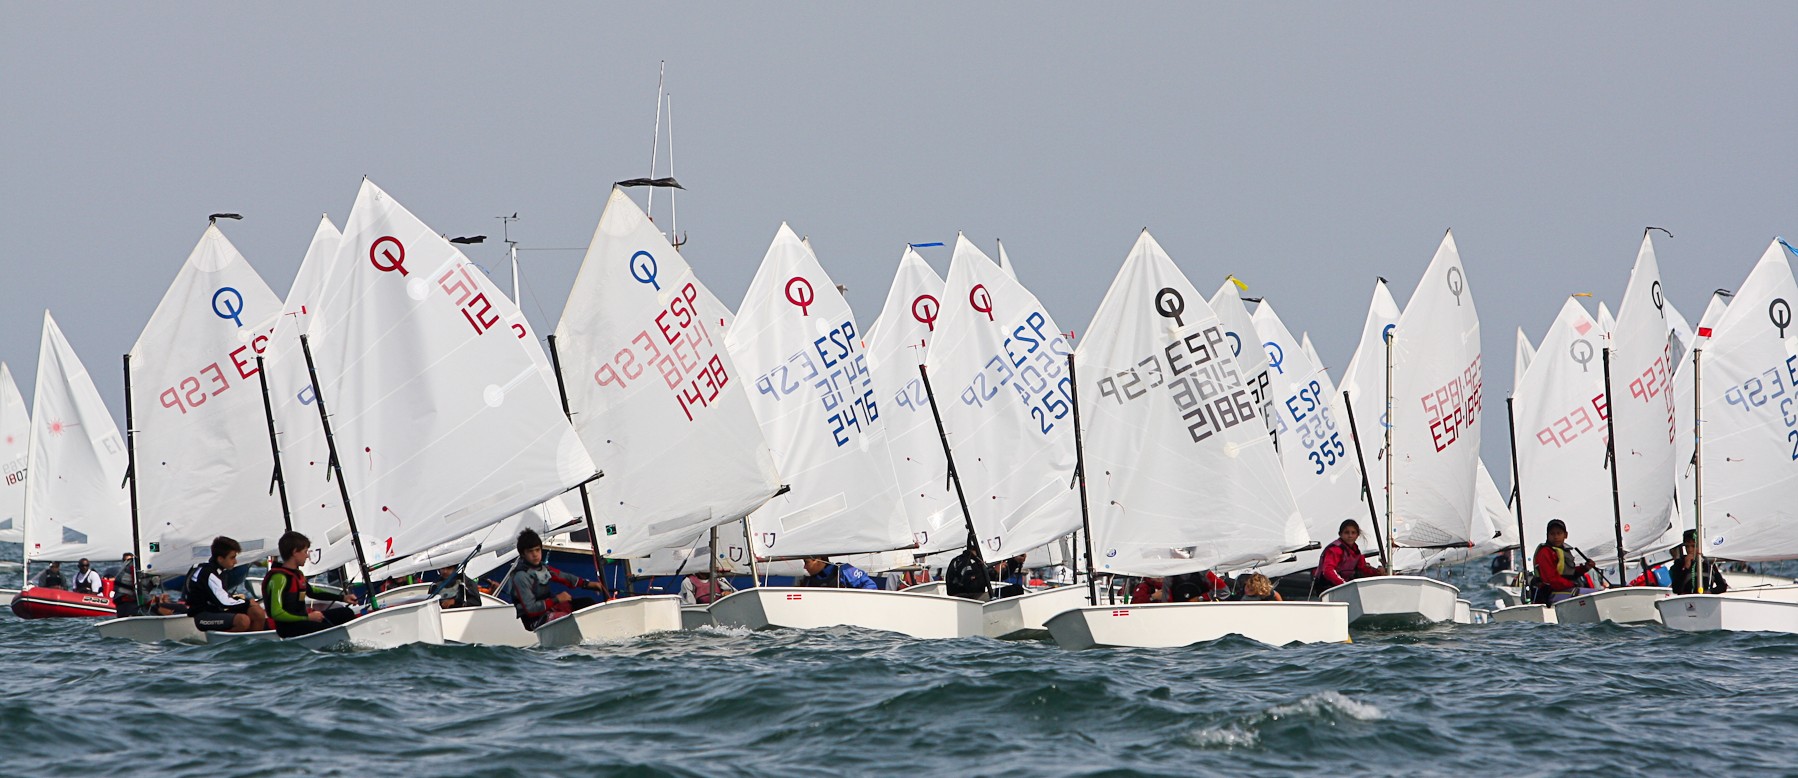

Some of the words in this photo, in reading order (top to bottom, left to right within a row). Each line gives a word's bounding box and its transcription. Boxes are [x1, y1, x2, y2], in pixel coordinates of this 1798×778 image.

[461, 292, 500, 336] 12
[655, 282, 697, 345] ESP
[1004, 311, 1046, 369] ESP
[229, 327, 275, 380] ES
[814, 321, 855, 369] ESP
[1165, 326, 1223, 376] ESP
[676, 353, 729, 422] 1438
[1031, 376, 1074, 435] 250
[1246, 370, 1269, 404] SP
[1285, 380, 1321, 423] ESP
[827, 389, 879, 447] 2476
[1182, 389, 1255, 443] 2186
[1308, 431, 1345, 475] 355
